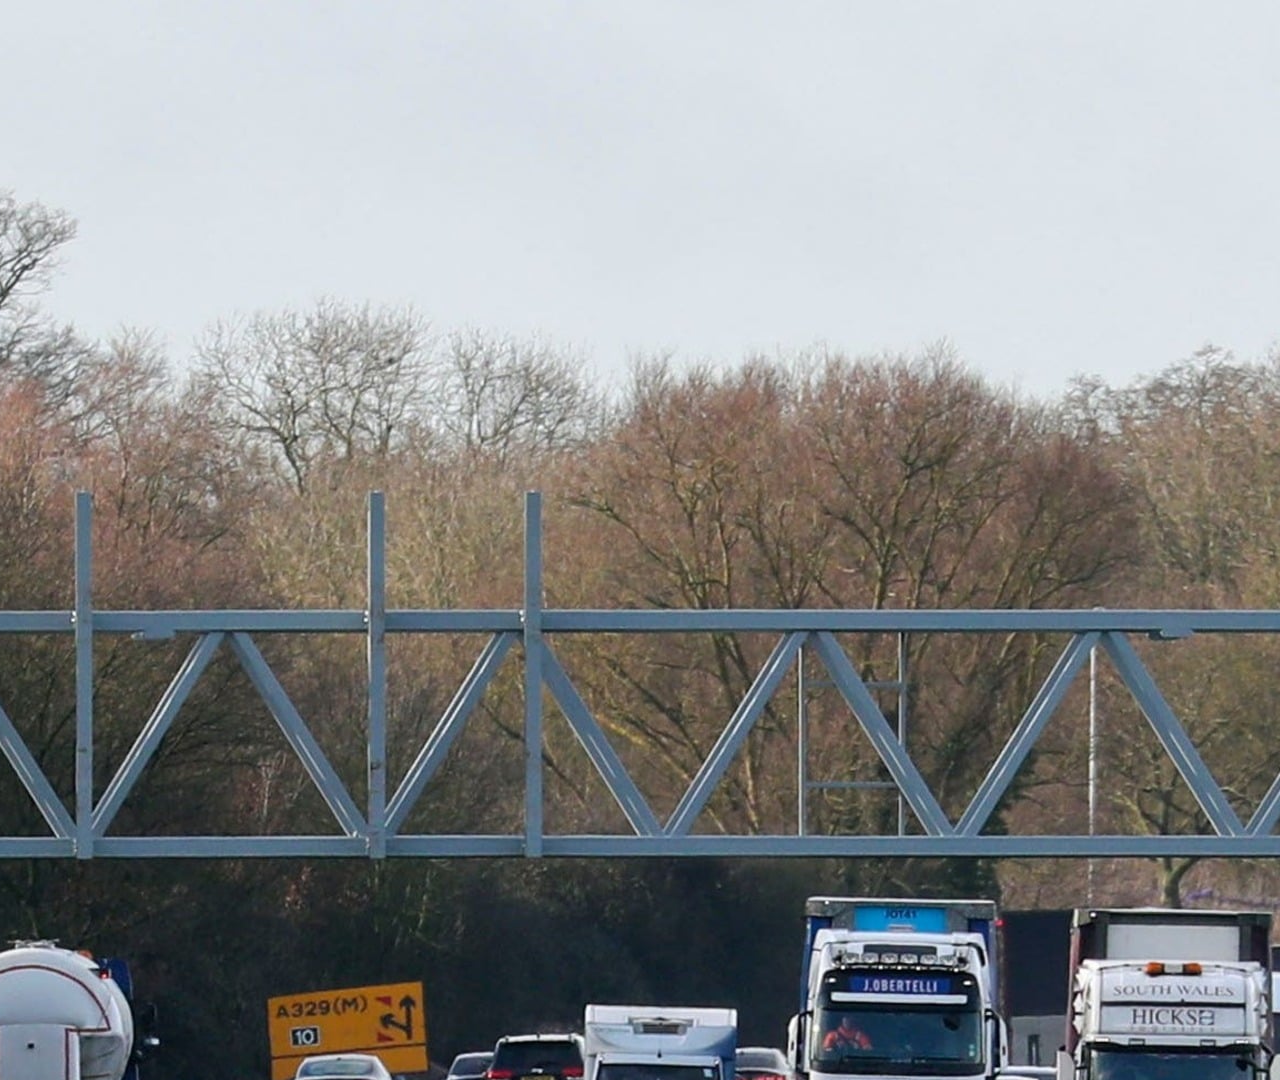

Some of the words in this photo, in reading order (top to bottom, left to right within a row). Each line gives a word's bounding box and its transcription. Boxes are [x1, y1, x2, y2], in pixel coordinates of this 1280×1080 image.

[863, 979, 938, 993] J.OBERTELLI
[1113, 985, 1171, 997] SOUTH
[1177, 985, 1234, 997] WALES
[276, 995, 368, 1018] A329(M)
[1132, 1008, 1197, 1026] HICKS
[294, 1030, 315, 1045] 10
